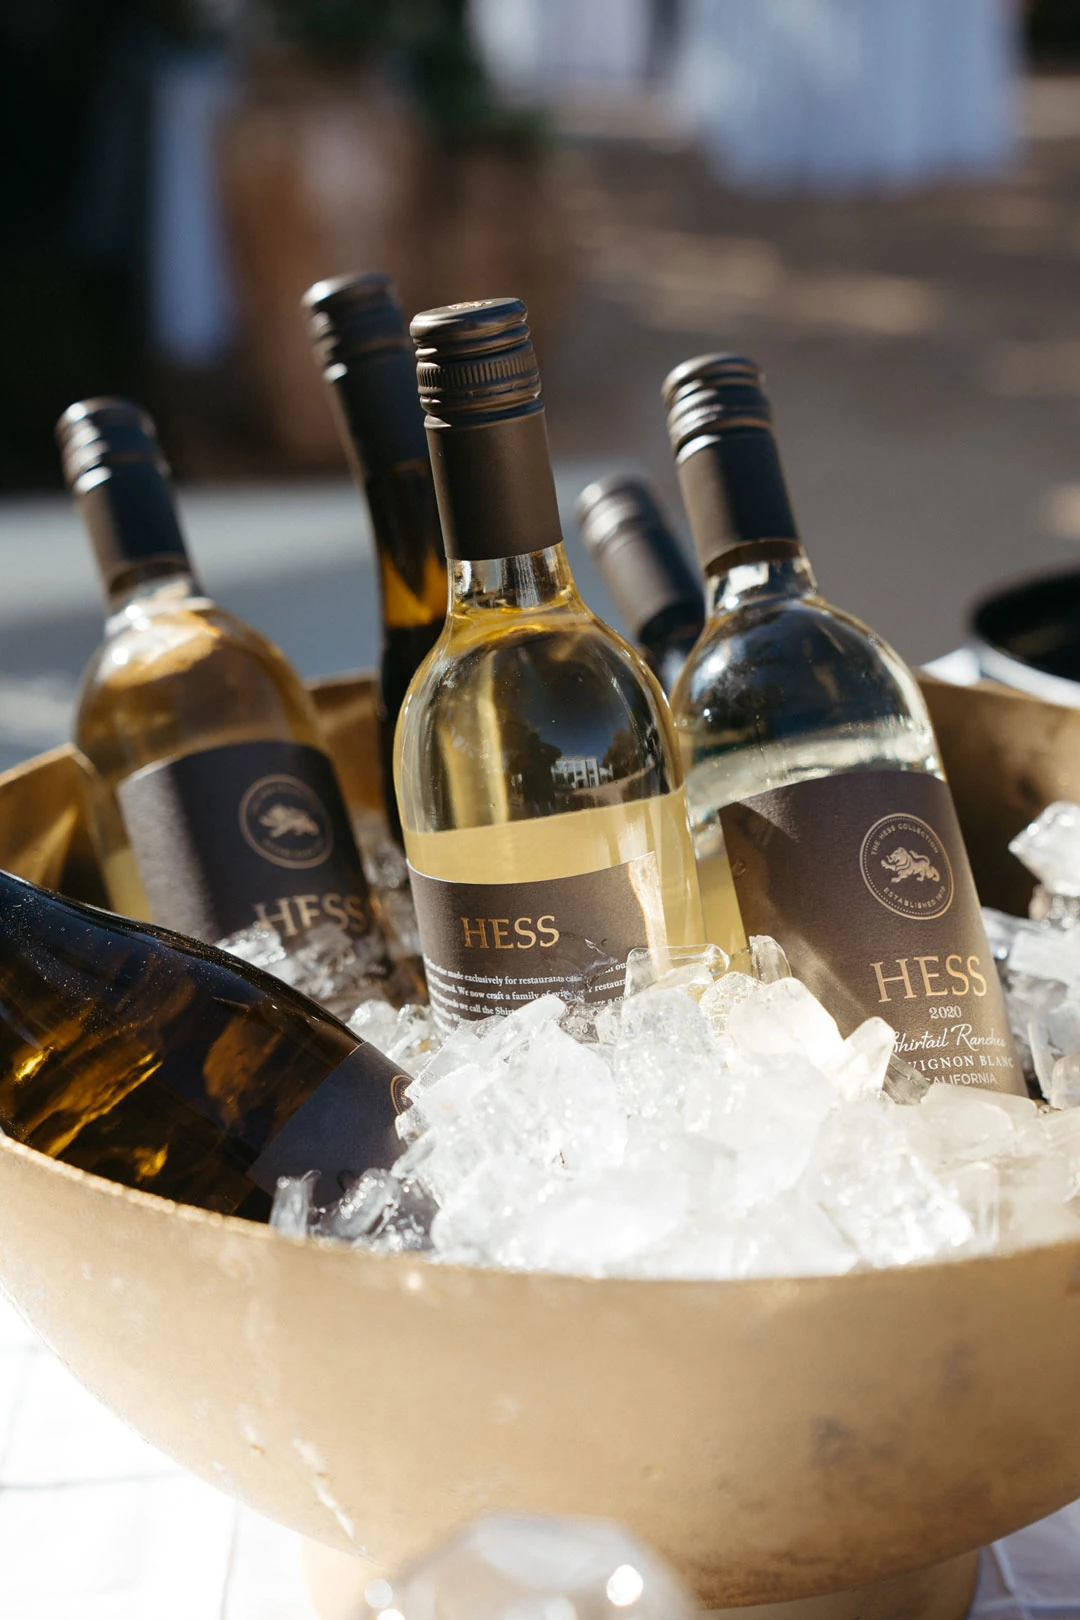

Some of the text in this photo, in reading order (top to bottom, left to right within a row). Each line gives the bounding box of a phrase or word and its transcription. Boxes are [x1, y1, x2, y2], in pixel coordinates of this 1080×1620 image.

[871, 823, 939, 855] THE HESS COLLECTION
[883, 887, 936, 909] ESTABLISHED
[460, 915, 560, 949] HESS
[464, 973, 503, 987] exclusively
[505, 976, 519, 985] for
[519, 976, 564, 985] restaurants
[615, 961, 627, 969] ou
[869, 954, 987, 1003] HESS
[457, 986, 469, 996] We
[469, 990, 485, 998] now
[486, 991, 504, 1000] craft
[512, 991, 539, 1001] family
[469, 1004, 482, 1014] call
[482, 1005, 494, 1015] the
[494, 1006, 515, 1016] Shir
[928, 1005, 962, 1020] 2020
[978, 1054, 1015, 1069] BLANC
[925, 1072, 998, 1085] ALIFORNIA
